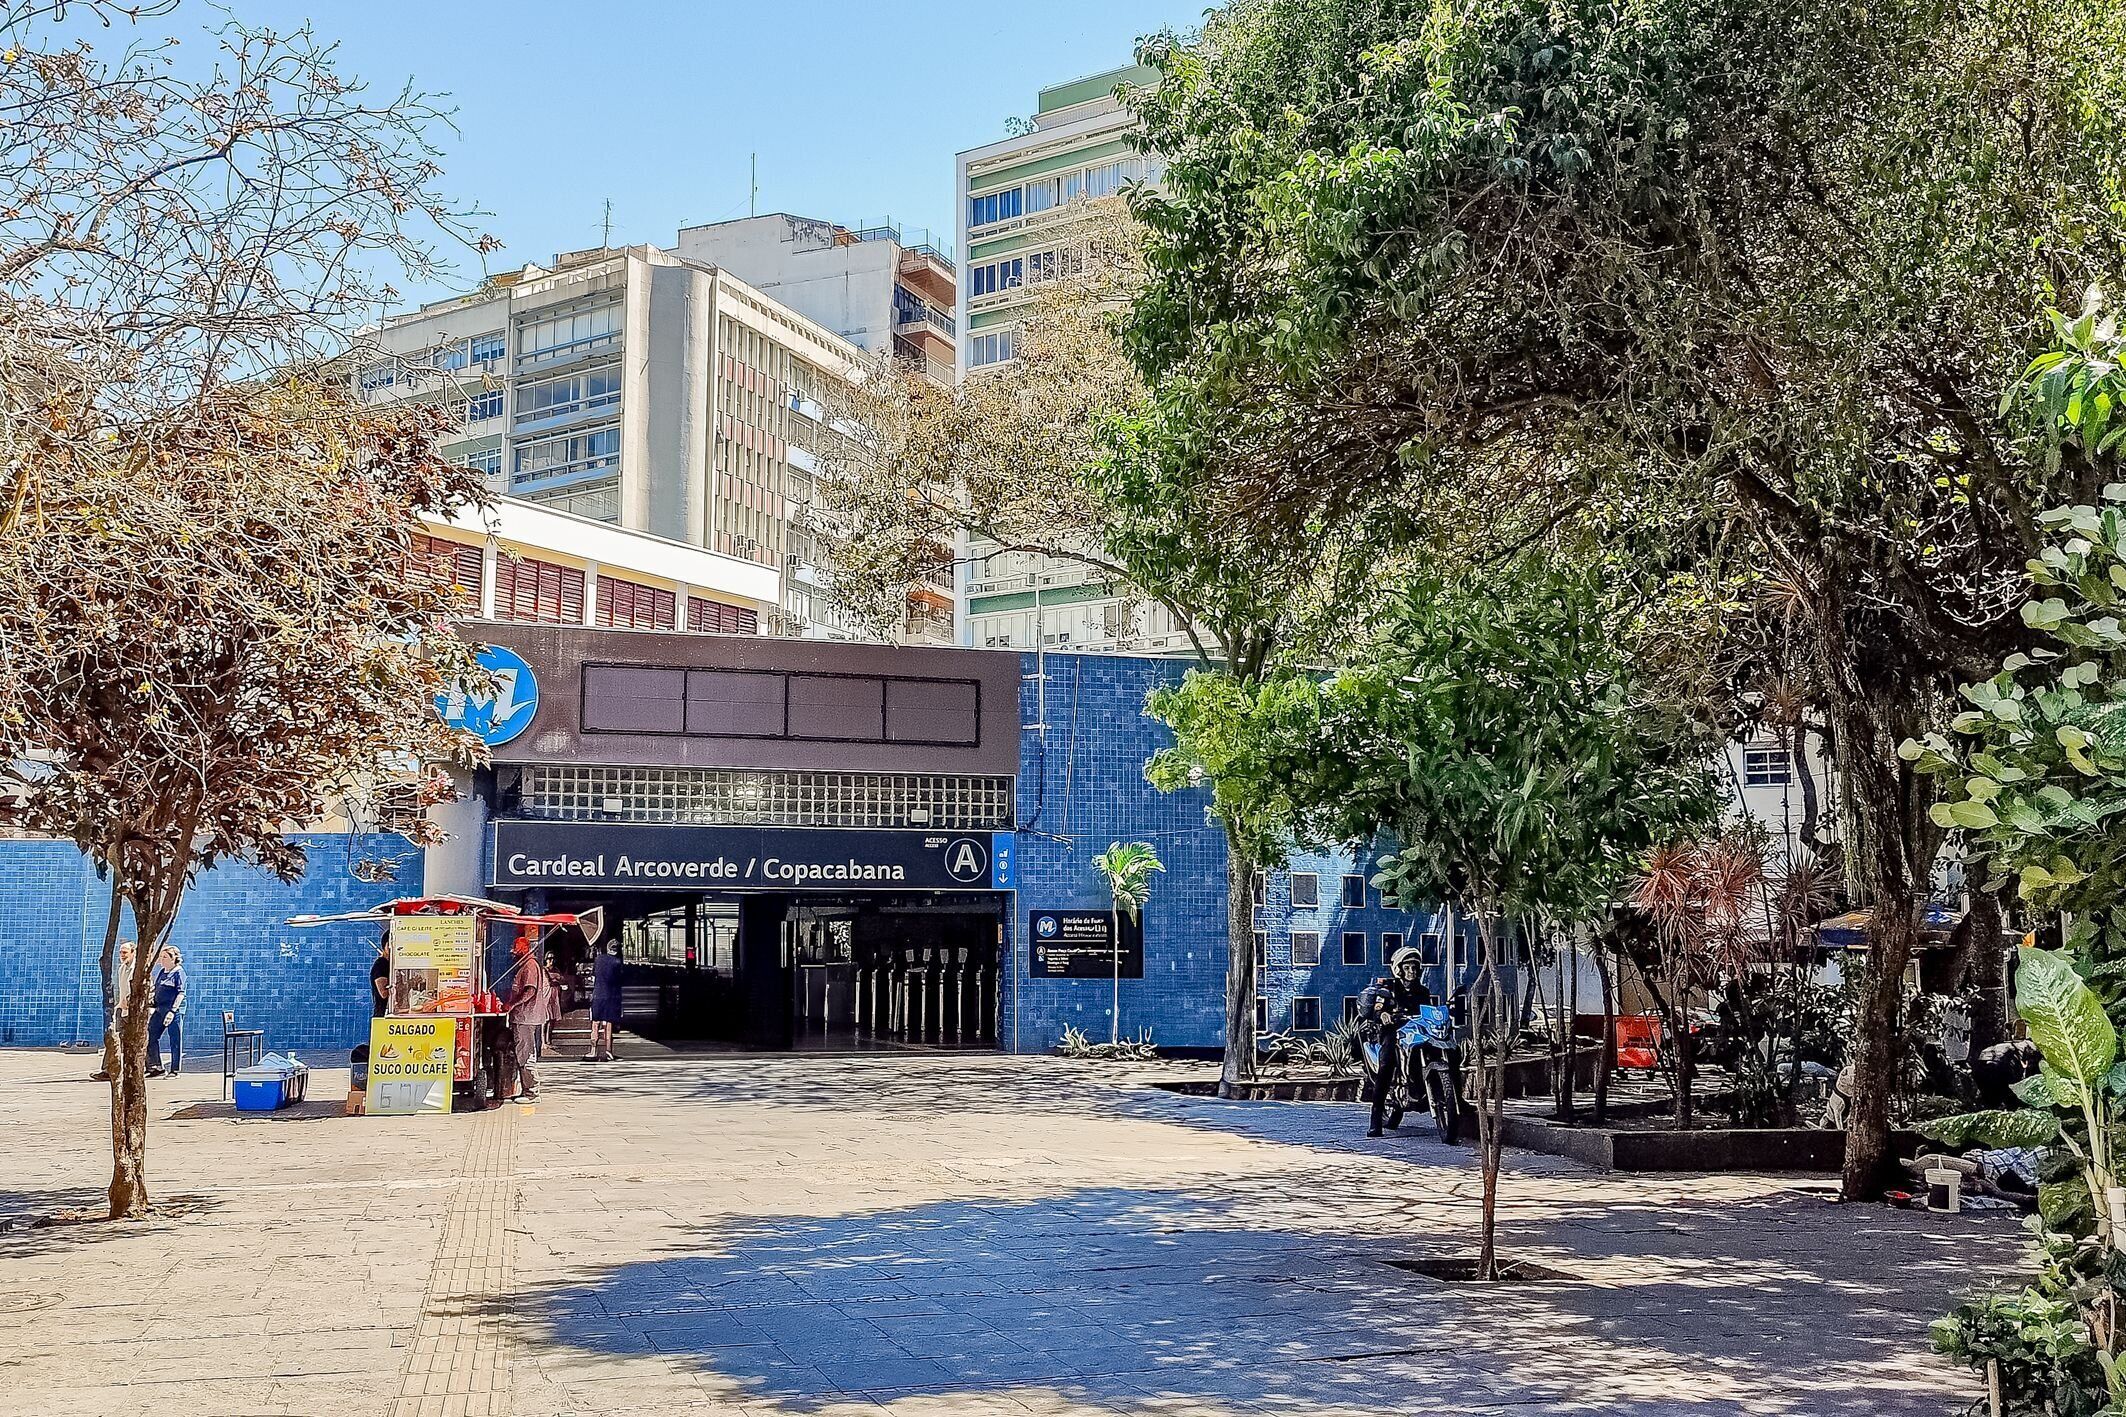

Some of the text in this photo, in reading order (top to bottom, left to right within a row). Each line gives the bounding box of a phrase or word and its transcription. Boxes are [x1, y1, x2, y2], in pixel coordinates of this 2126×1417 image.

[508, 853, 905, 885] Cardeal Arcoverde / Copacabana
[953, 844, 979, 873] A
[388, 1024, 436, 1036] SALGADO
[373, 1060, 448, 1075] SUCO OU CAFÉ
